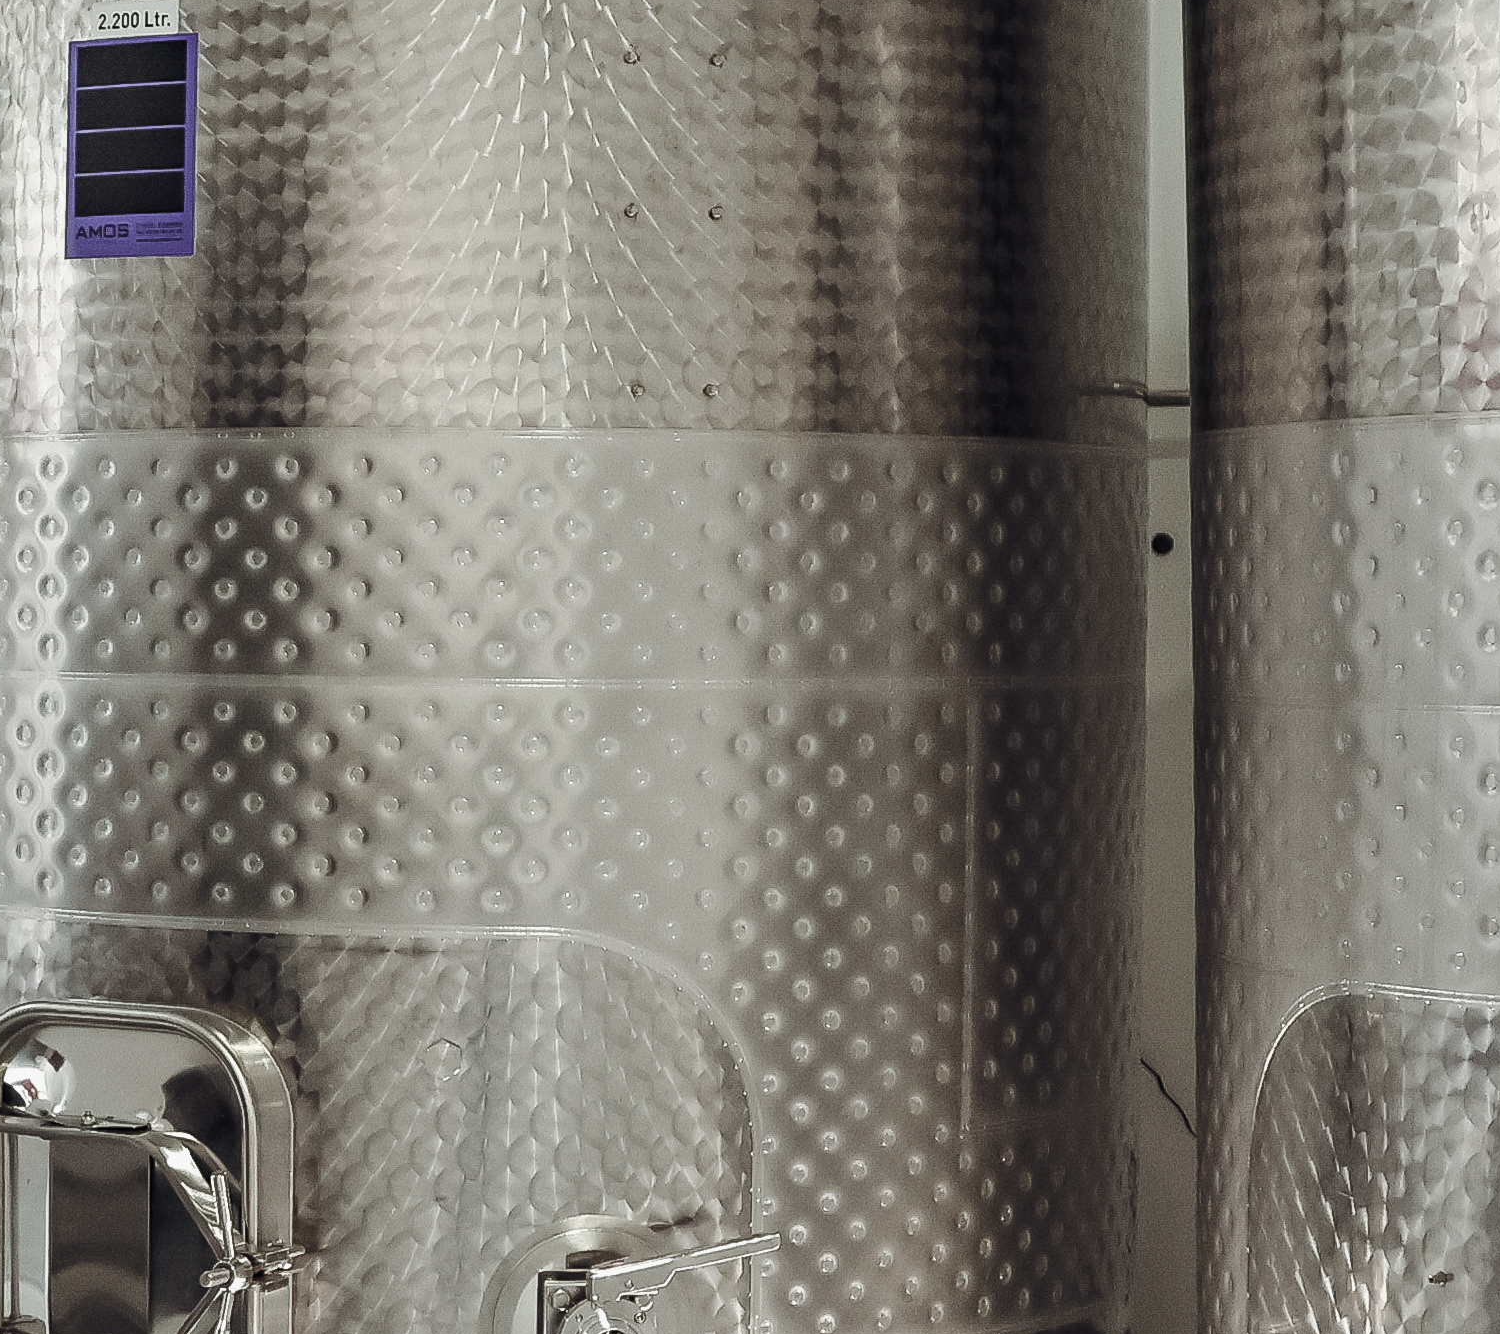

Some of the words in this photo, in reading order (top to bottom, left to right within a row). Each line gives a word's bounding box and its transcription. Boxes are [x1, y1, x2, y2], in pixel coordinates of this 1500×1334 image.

[98, 11, 140, 30] 2.200
[144, 10, 171, 28] Ltr.
[75, 223, 129, 240] AMOS
